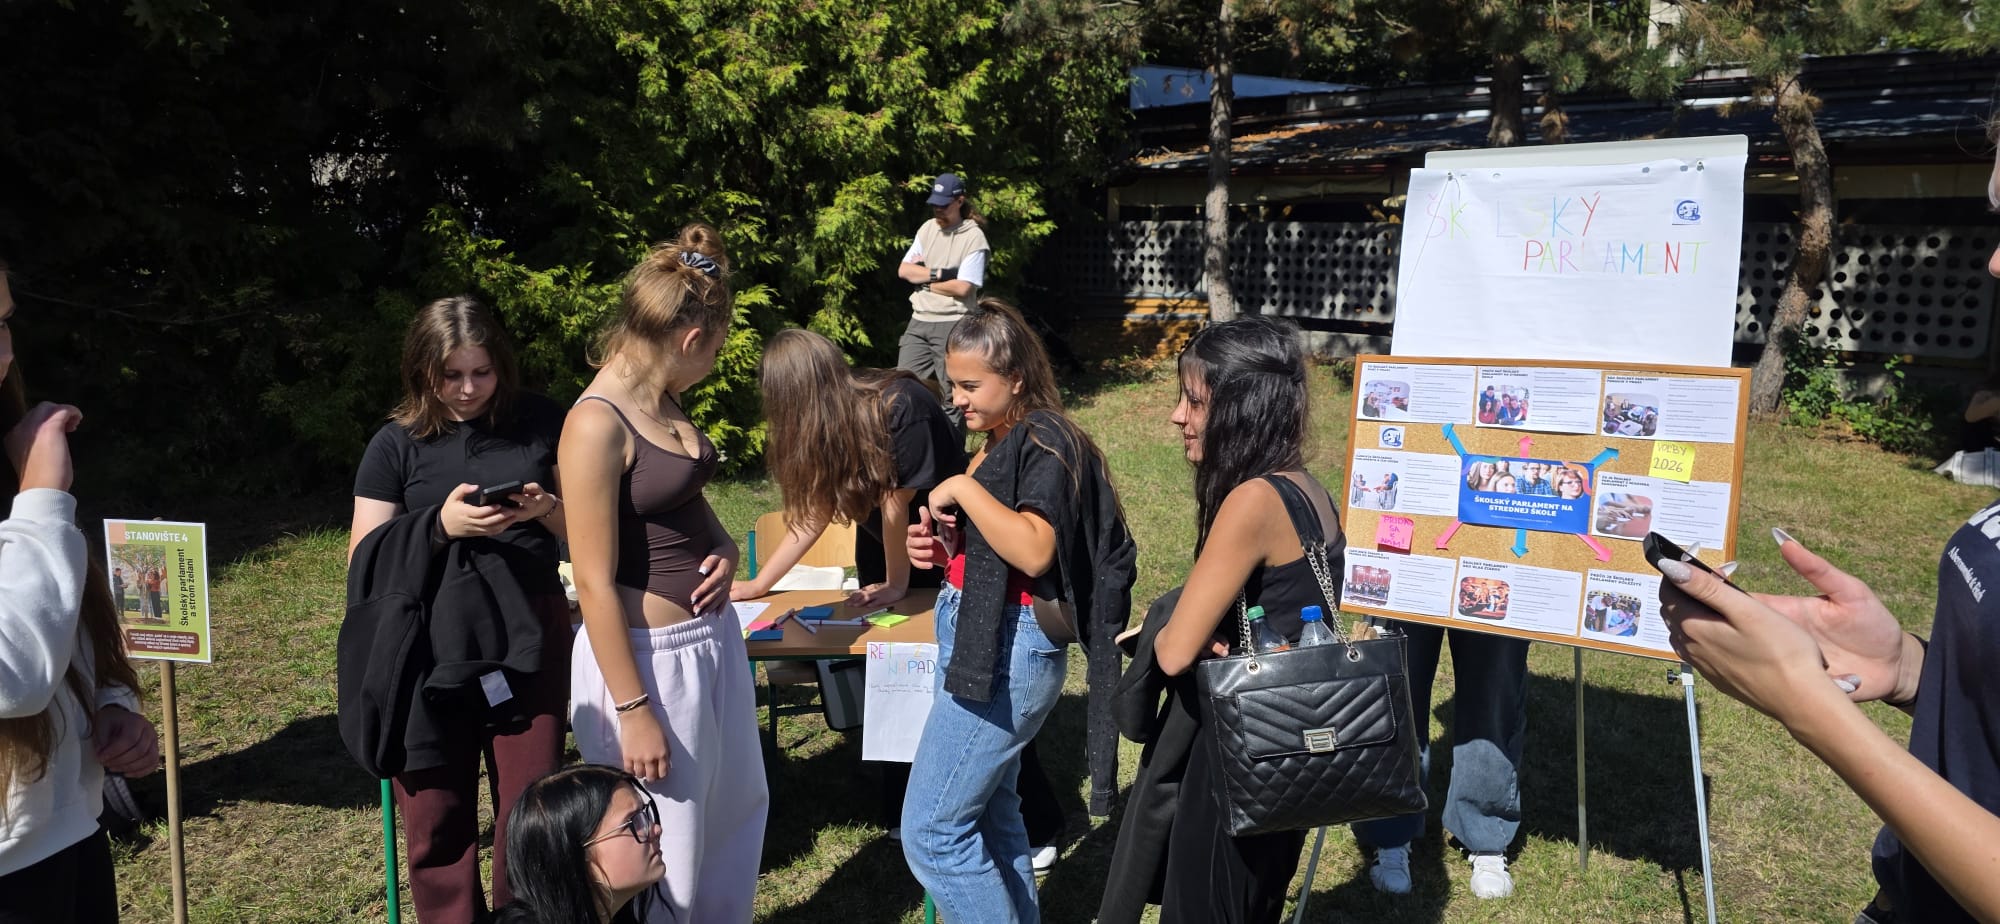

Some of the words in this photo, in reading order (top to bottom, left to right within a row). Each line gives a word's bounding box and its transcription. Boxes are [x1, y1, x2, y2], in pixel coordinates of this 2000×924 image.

[1424, 191, 1600, 240] ŠKLSKÝ
[1652, 457, 1683, 473] 2026
[1474, 495, 1510, 506] ŠKOLSKÝ
[1511, 499, 1560, 510] PARLAMENT
[1561, 503, 1573, 512] NA
[1488, 504, 1528, 514] STREDNEJ
[1530, 506, 1557, 517] ŠKOLE
[125, 530, 179, 543] STANOVIŠTE
[181, 535, 188, 543] 4
[177, 548, 188, 591] parlament
[178, 593, 188, 626] Školský
[188, 588, 196, 612] strom
